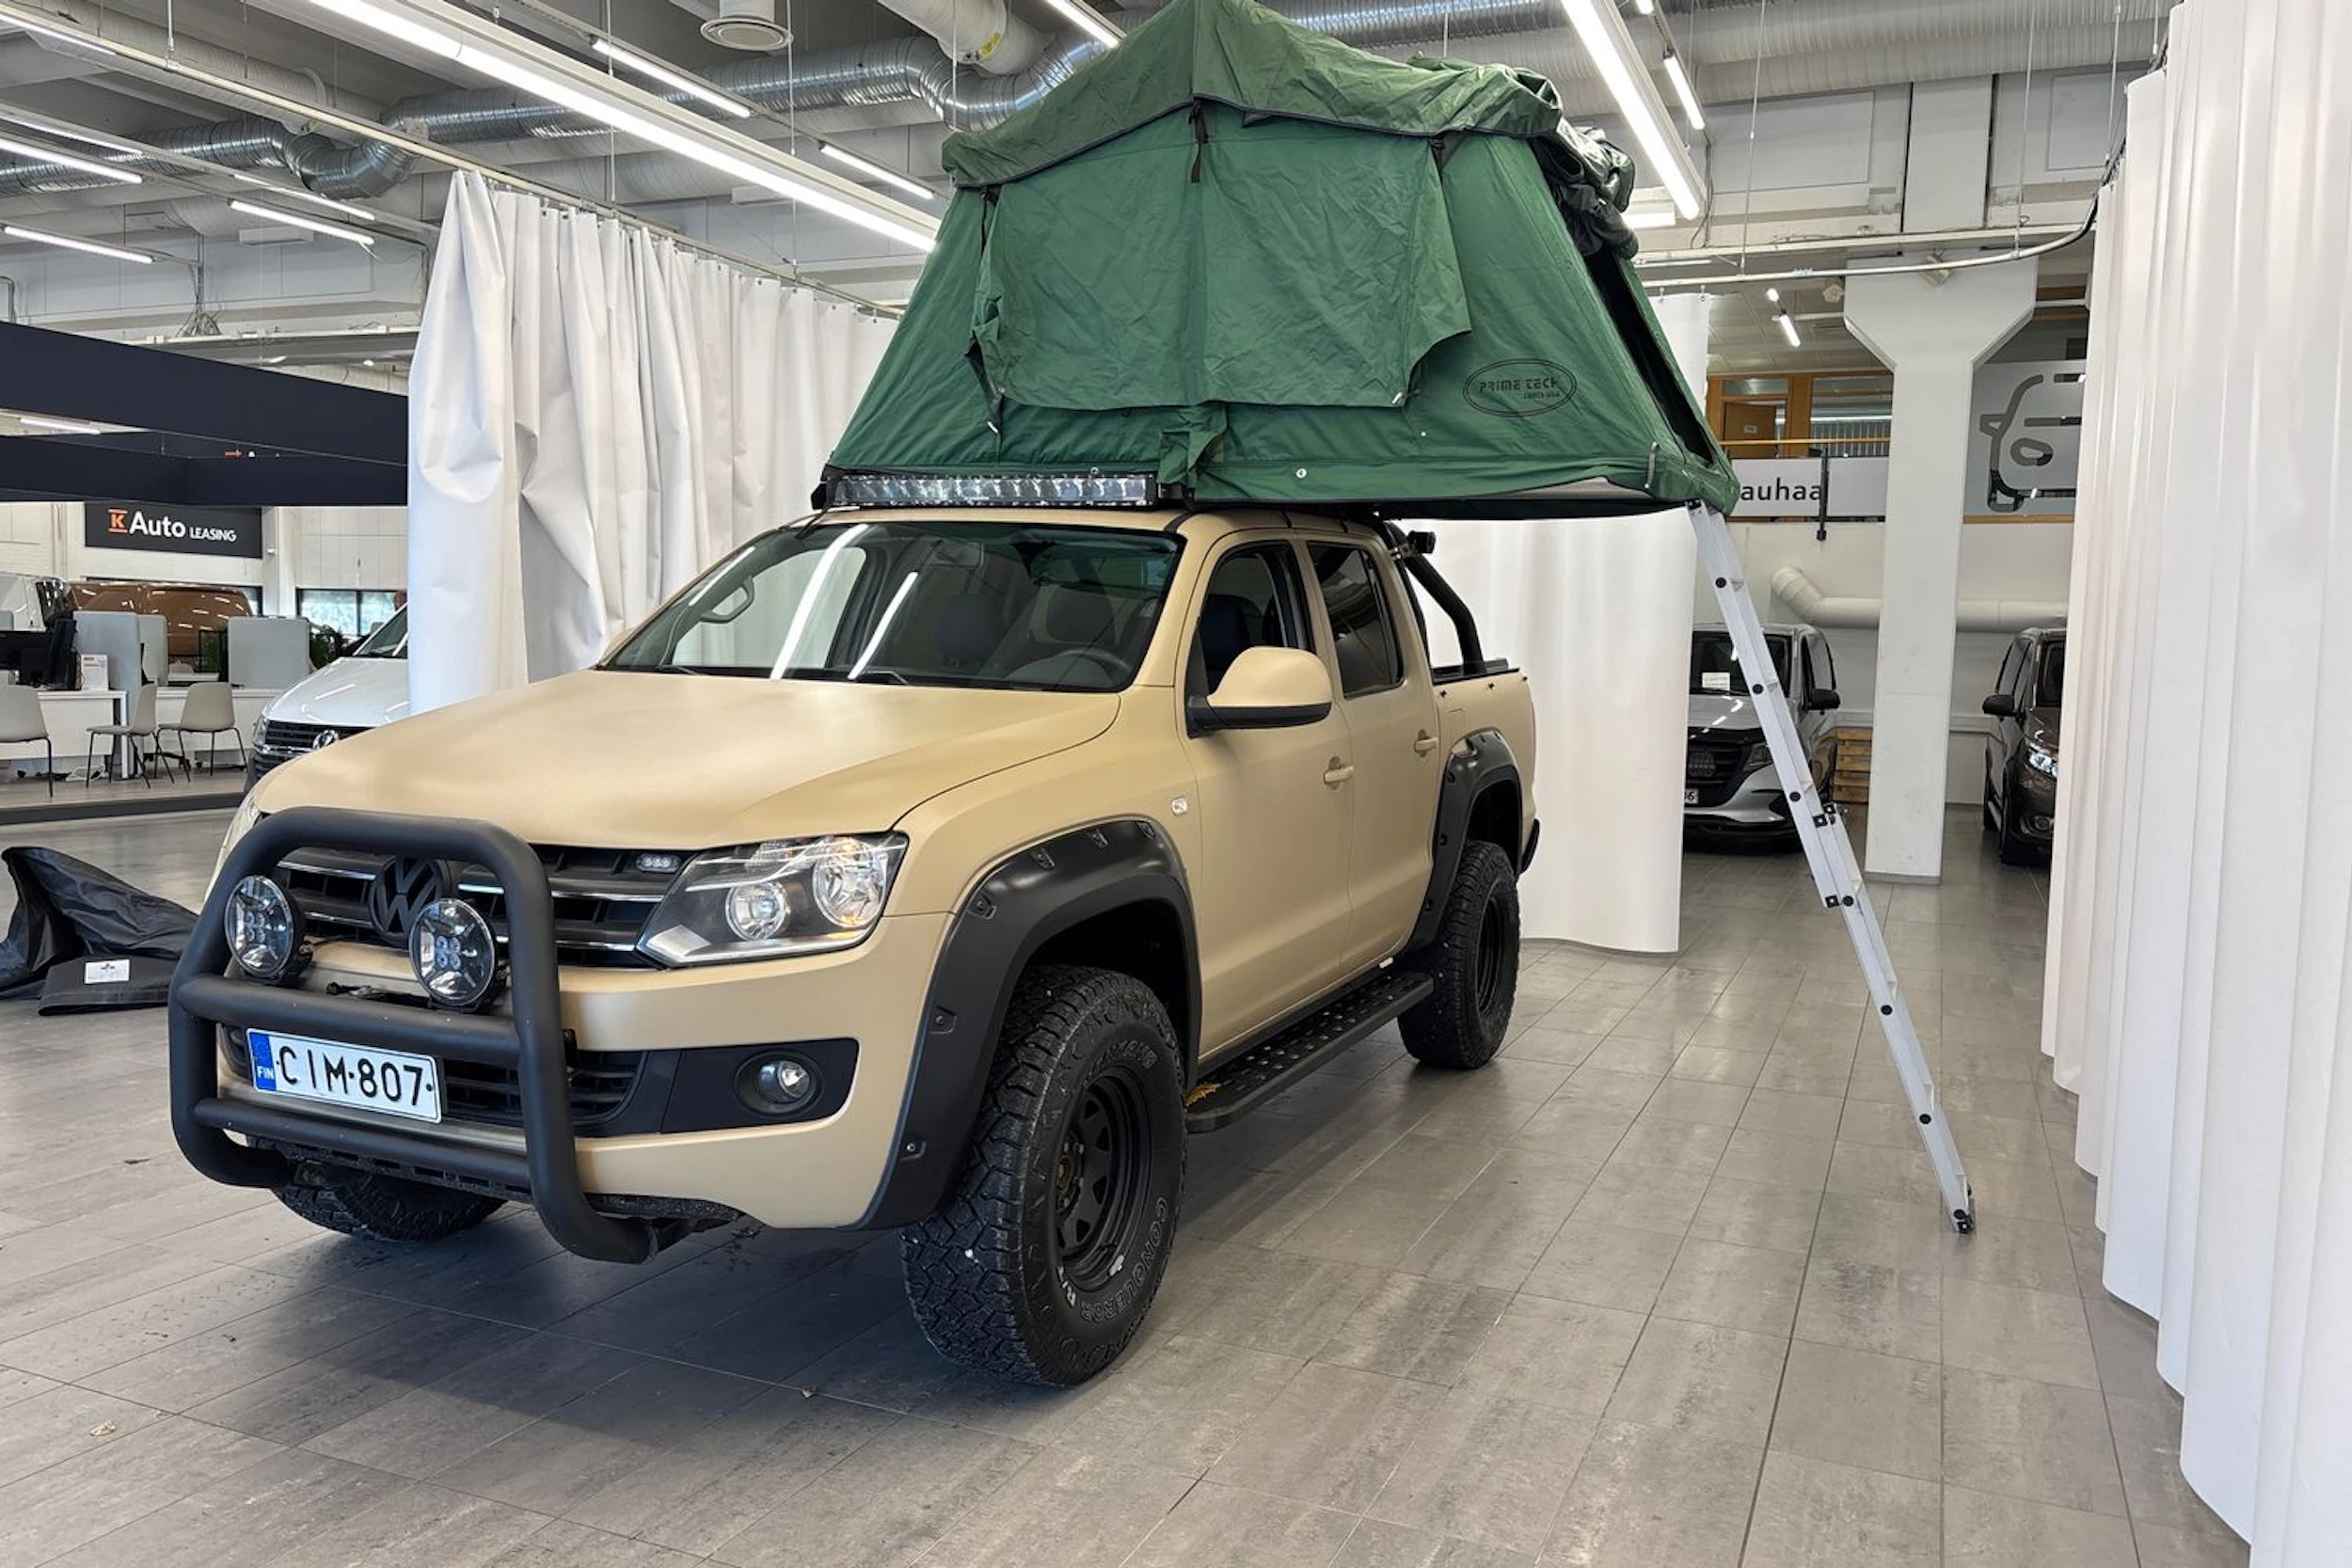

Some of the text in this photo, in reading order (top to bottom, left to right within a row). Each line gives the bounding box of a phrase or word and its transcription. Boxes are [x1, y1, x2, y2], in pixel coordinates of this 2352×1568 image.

[1480, 379, 1520, 392] PRIME
[109, 510, 237, 542] K Auto LEASING
[257, 1066, 274, 1081] FIN
[279, 1046, 423, 1106] CIM-807
[1082, 1196, 1168, 1323] CONQUEROR
